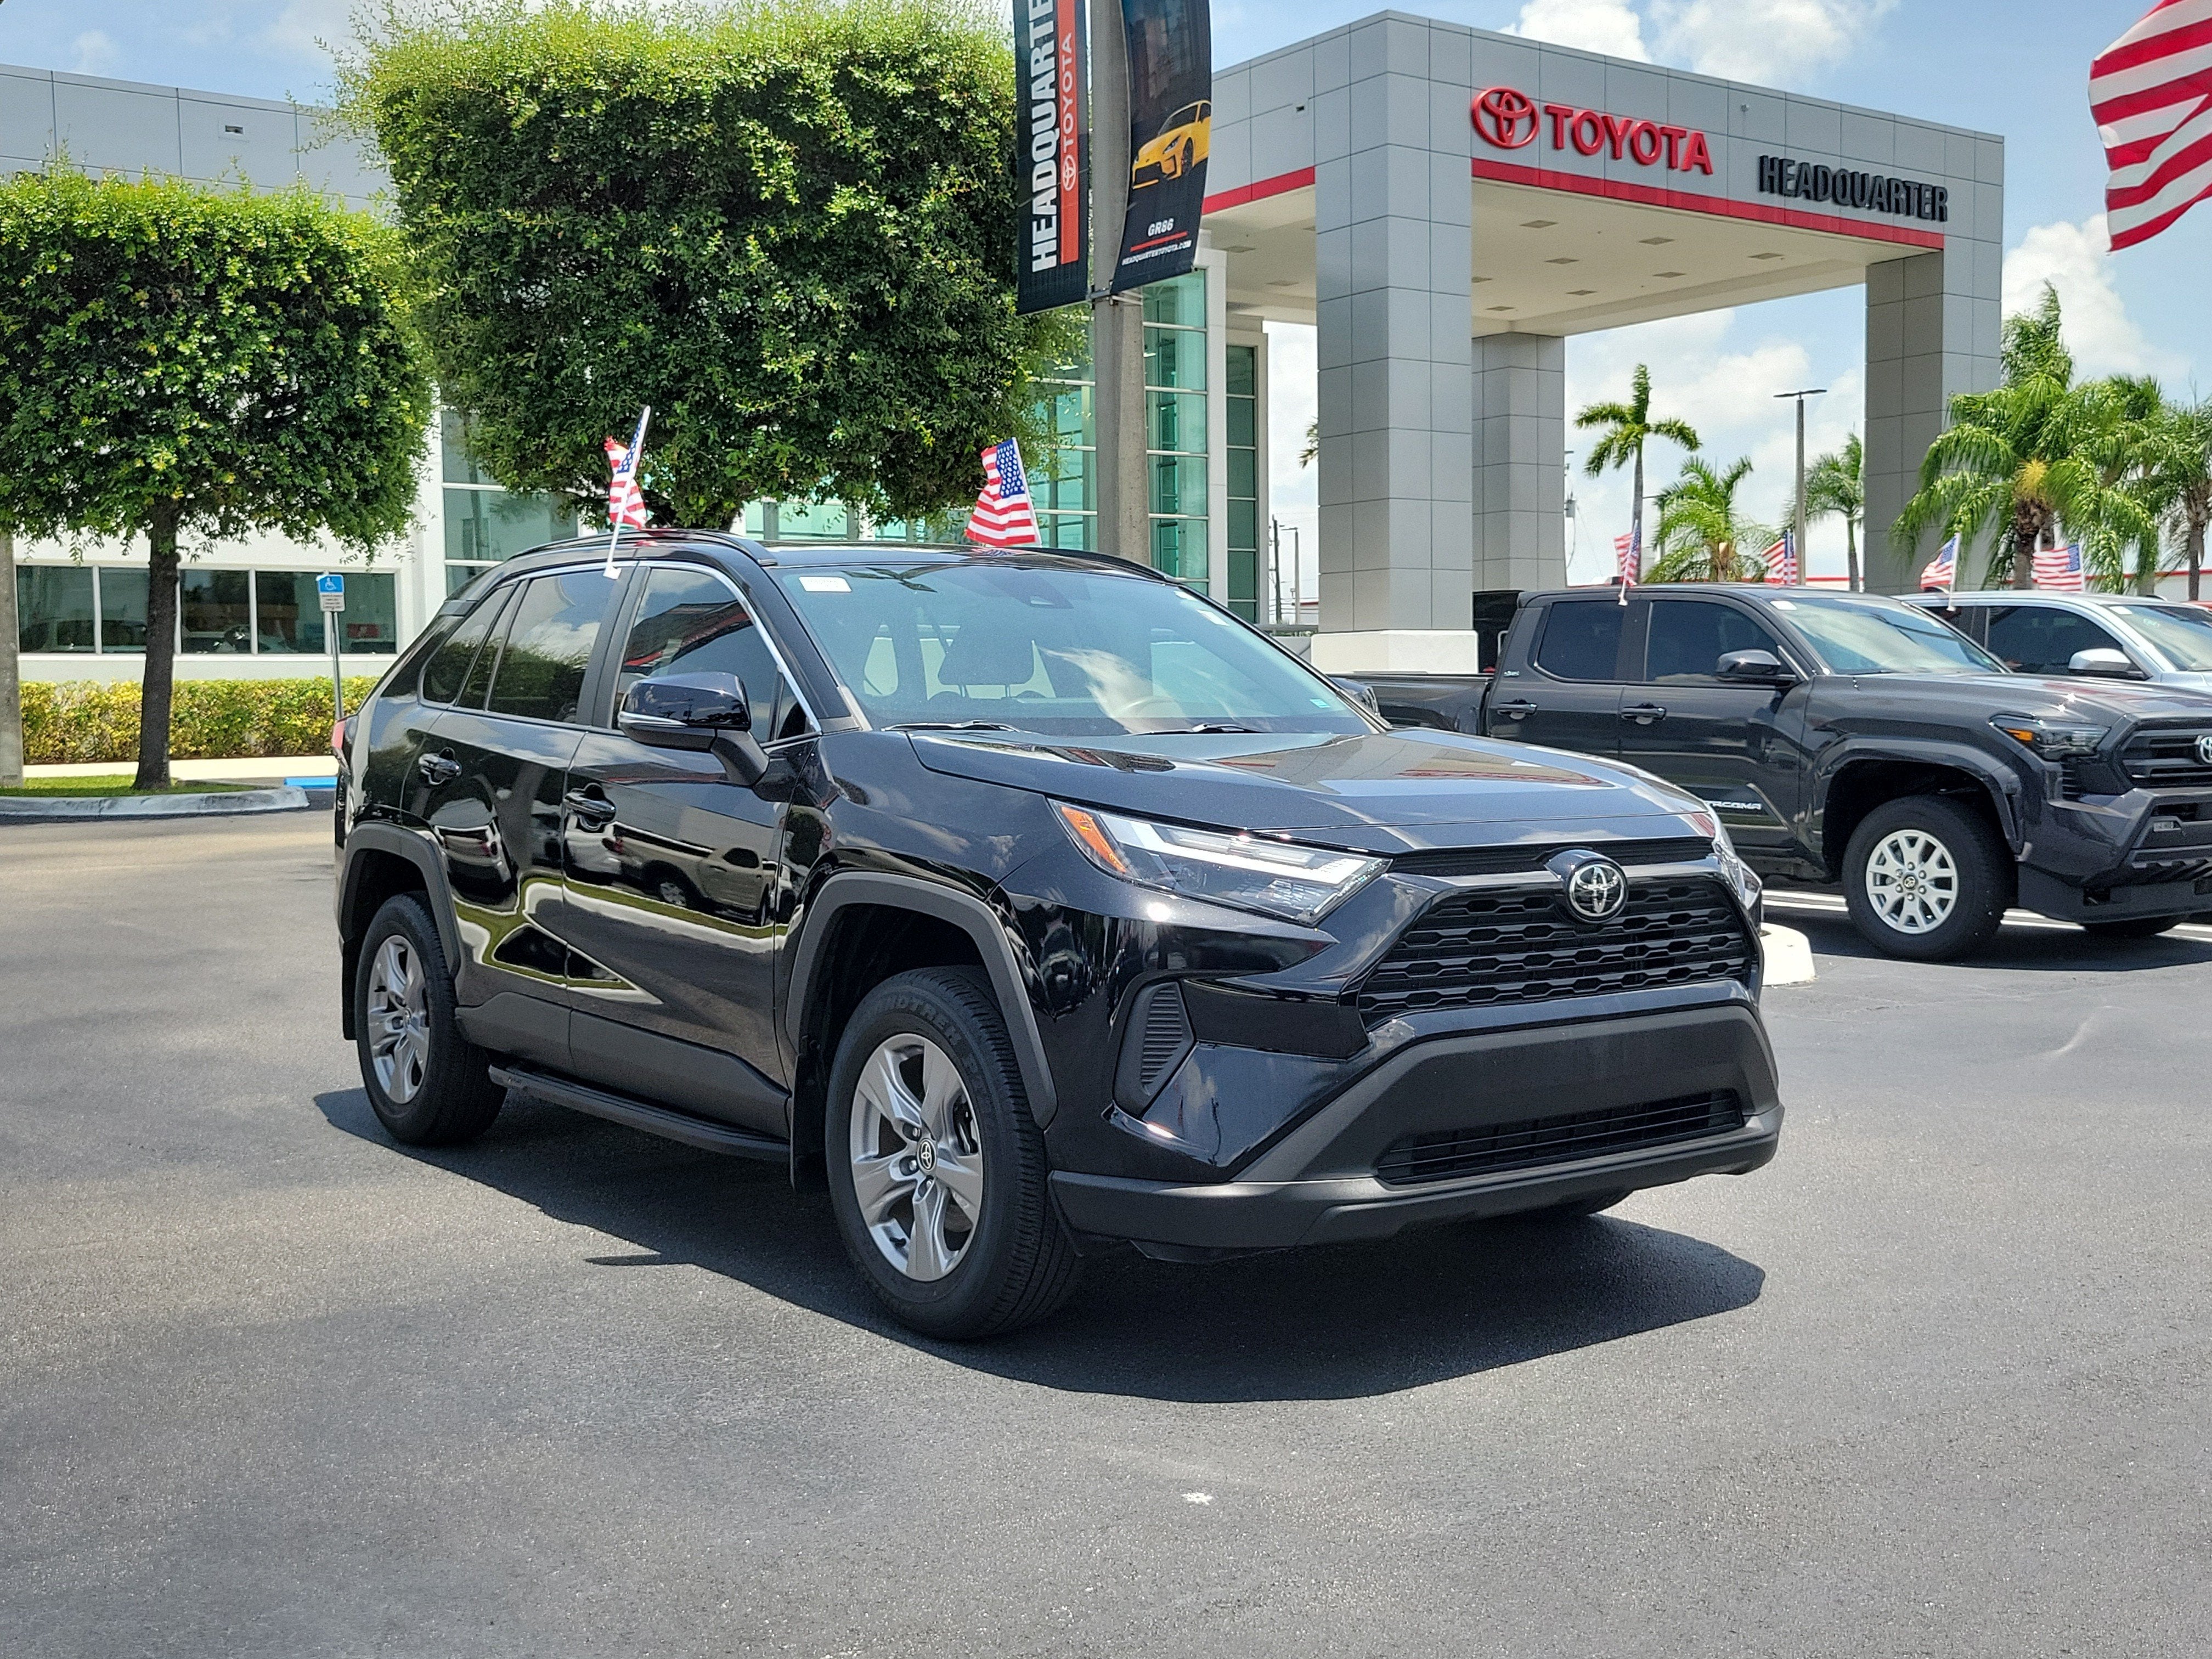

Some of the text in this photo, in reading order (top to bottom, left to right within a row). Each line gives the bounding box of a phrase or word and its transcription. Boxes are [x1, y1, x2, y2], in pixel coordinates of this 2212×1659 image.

[1062, 32, 1075, 153] TOYOTA
[1544, 104, 1714, 175] TOYOTA
[1759, 155, 1948, 222] HEADQUARTER
[1148, 218, 1174, 237] GR86
